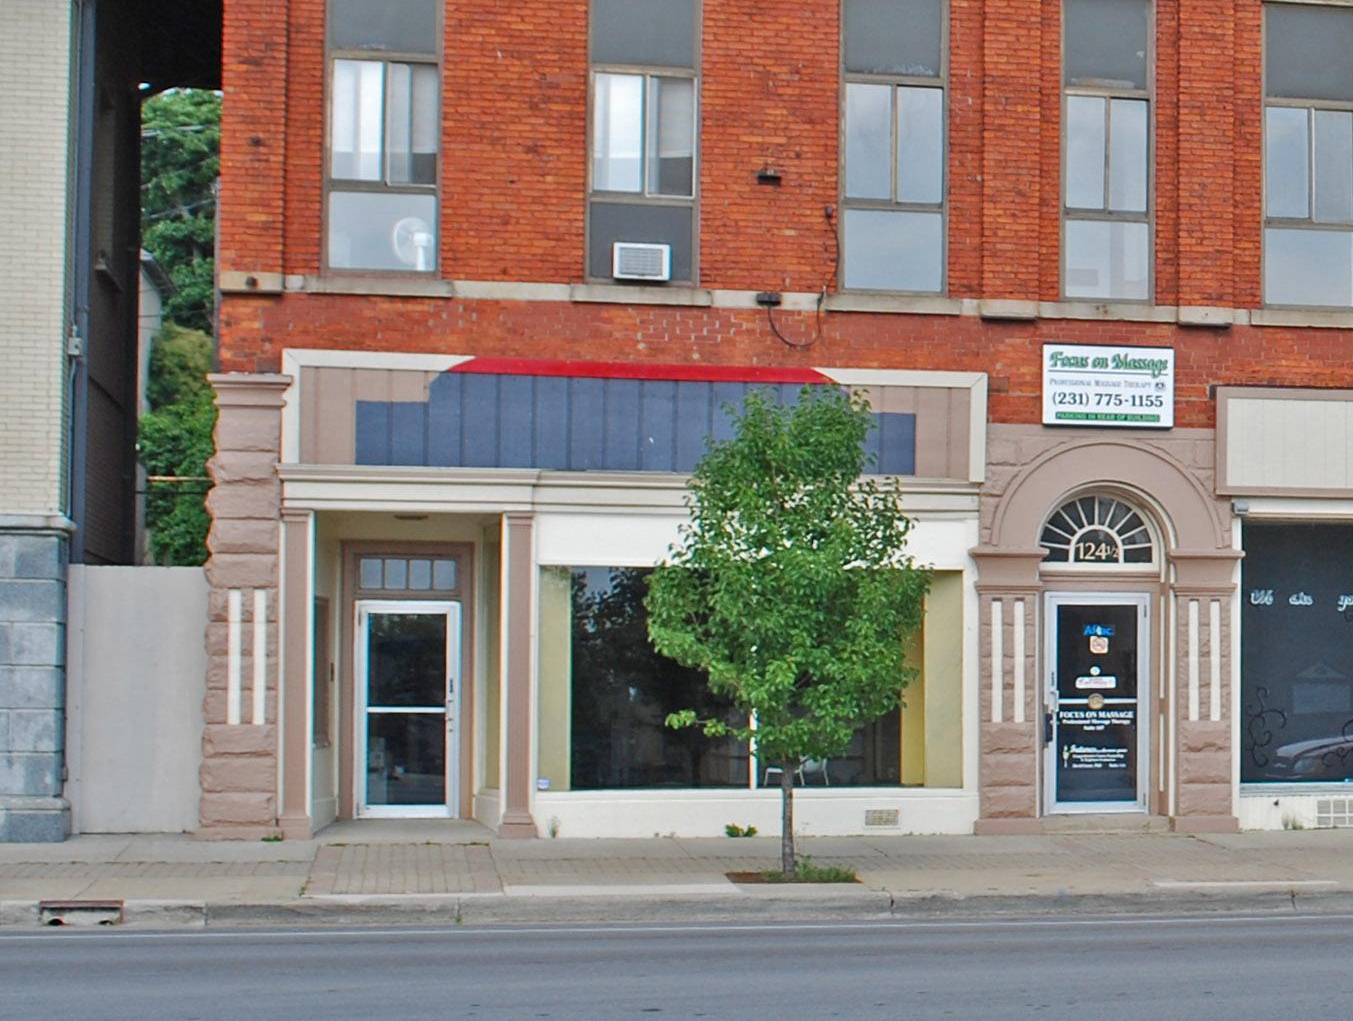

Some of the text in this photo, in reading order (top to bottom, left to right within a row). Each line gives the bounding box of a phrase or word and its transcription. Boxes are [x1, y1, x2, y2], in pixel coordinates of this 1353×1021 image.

[1050, 351, 1168, 378] Focus on Massage
[1053, 392, 1163, 407] (231) 775-1155
[1060, 711, 1085, 719] FOCUS
[1098, 711, 1134, 719] MASSAGE
